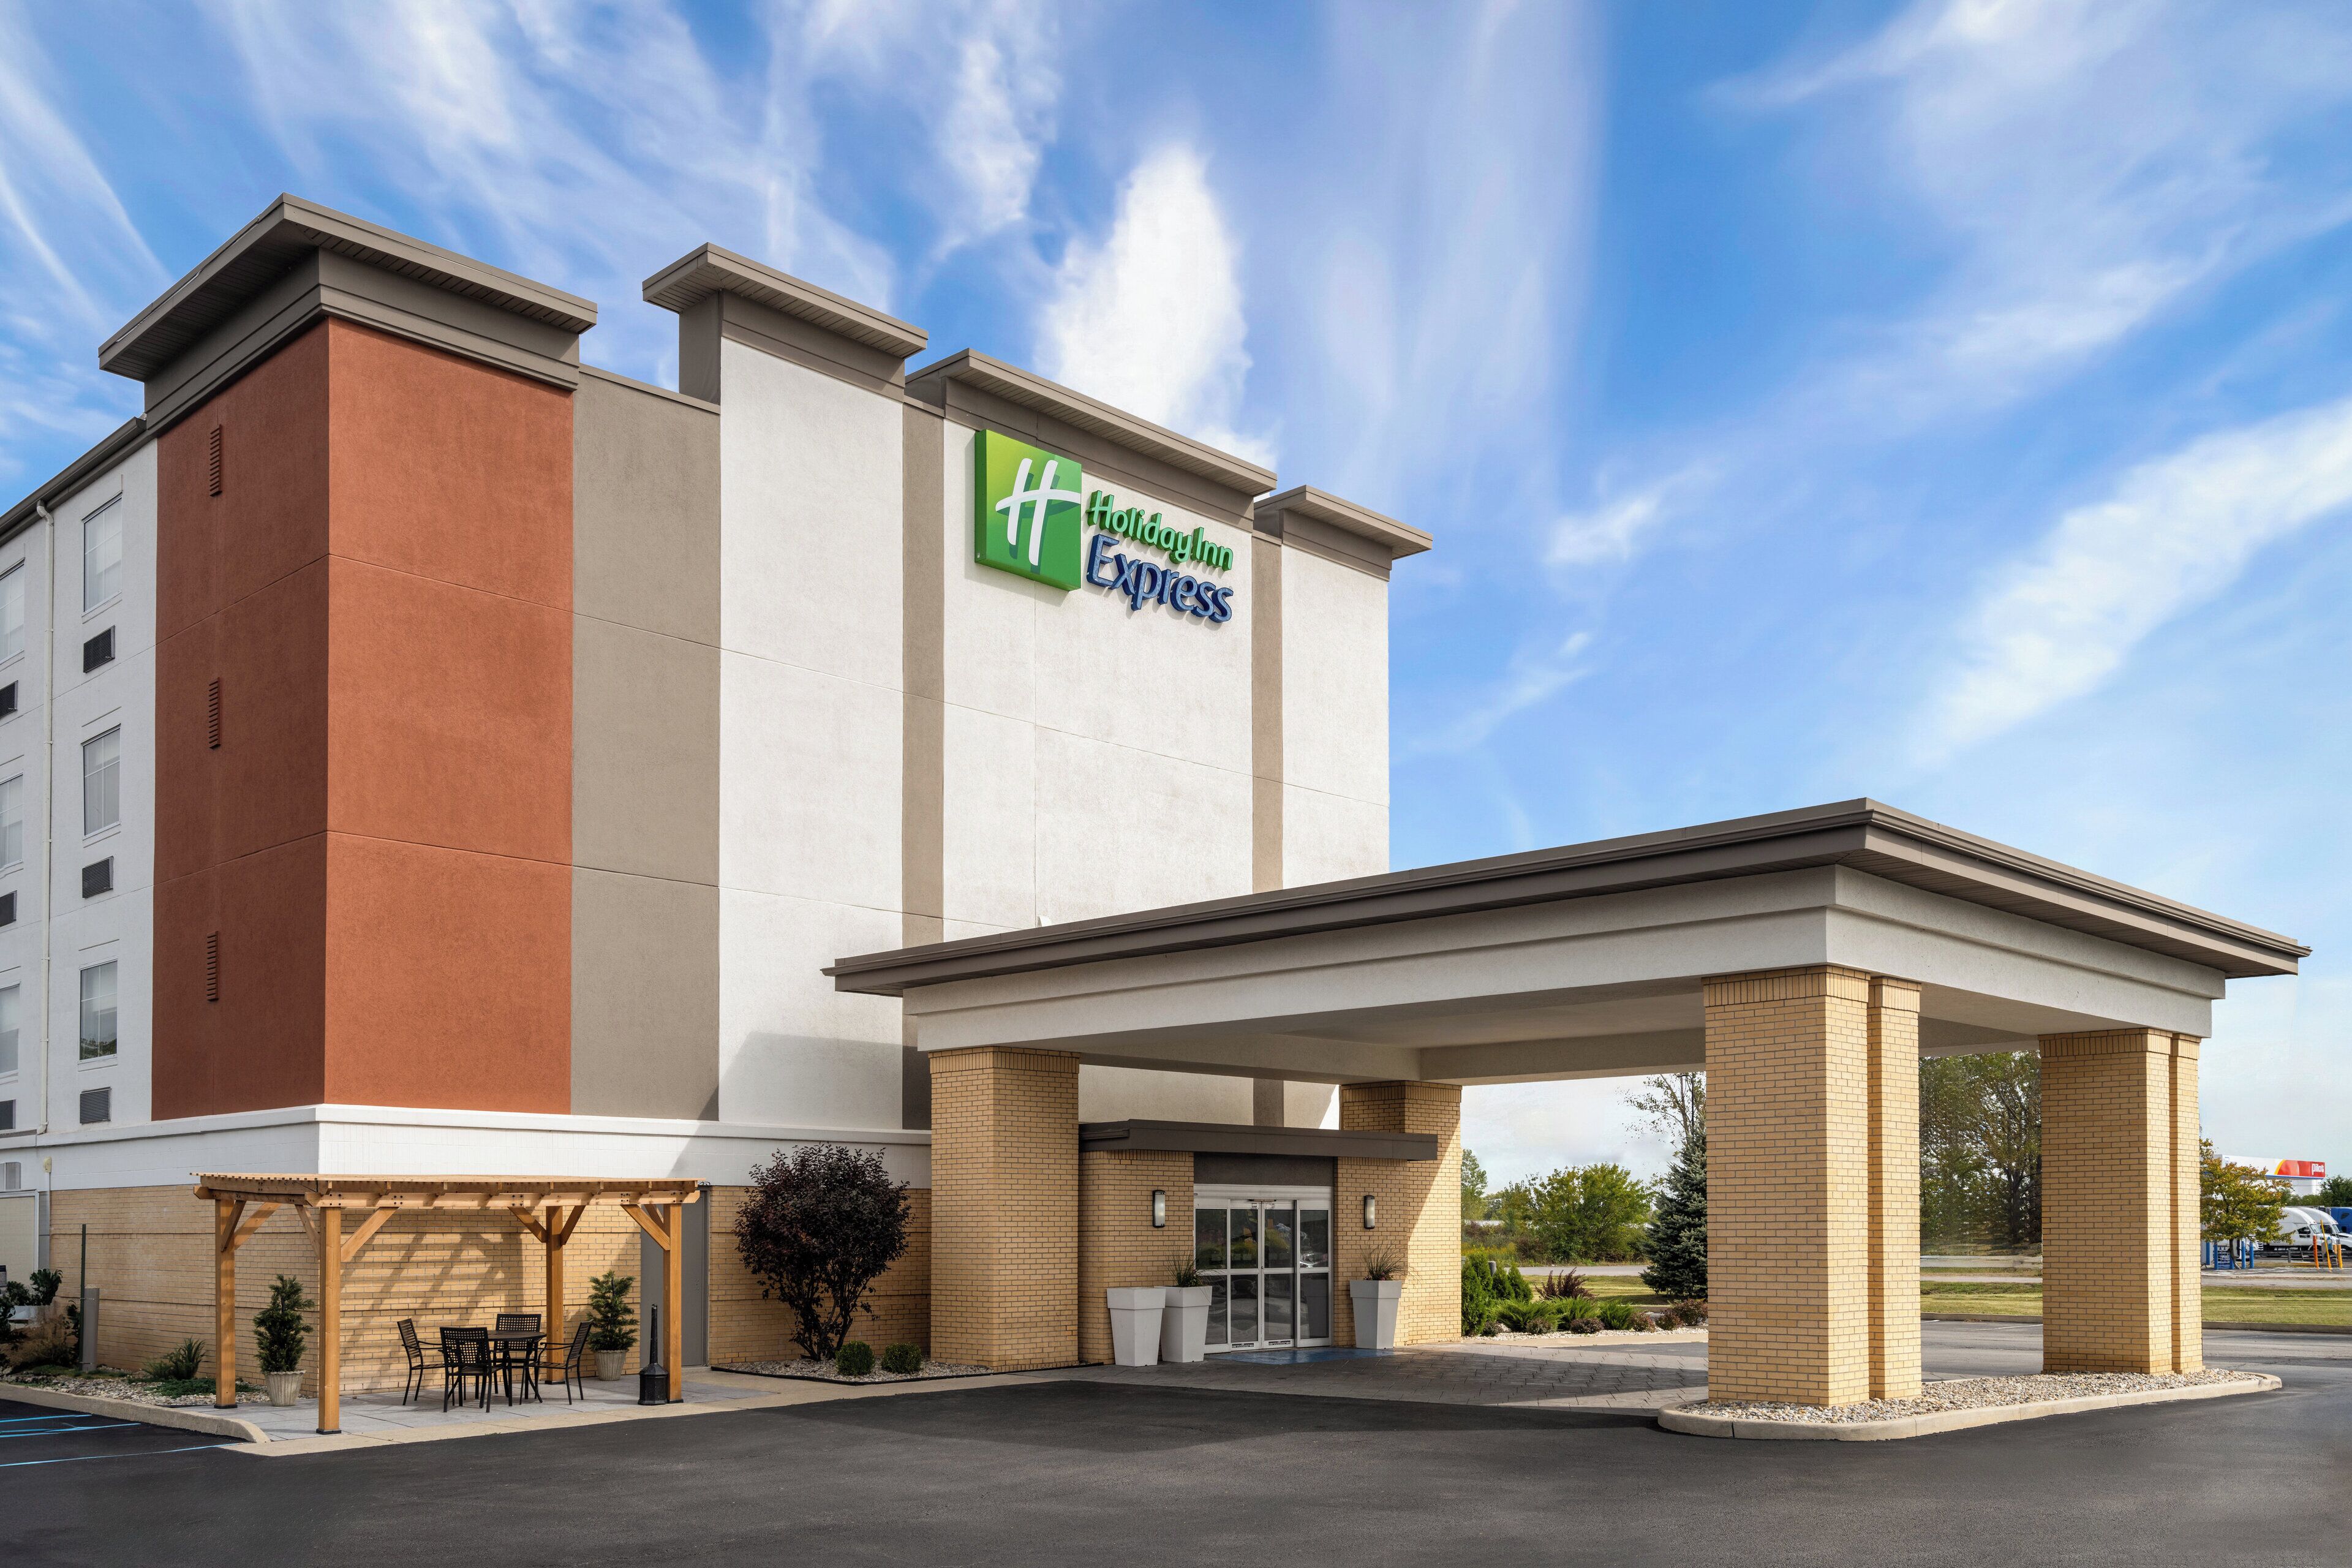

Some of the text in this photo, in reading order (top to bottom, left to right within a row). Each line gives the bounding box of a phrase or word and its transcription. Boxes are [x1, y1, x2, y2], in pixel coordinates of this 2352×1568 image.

[1085, 490, 1234, 571] Holiday Inn
[1086, 533, 1234, 624] Express
